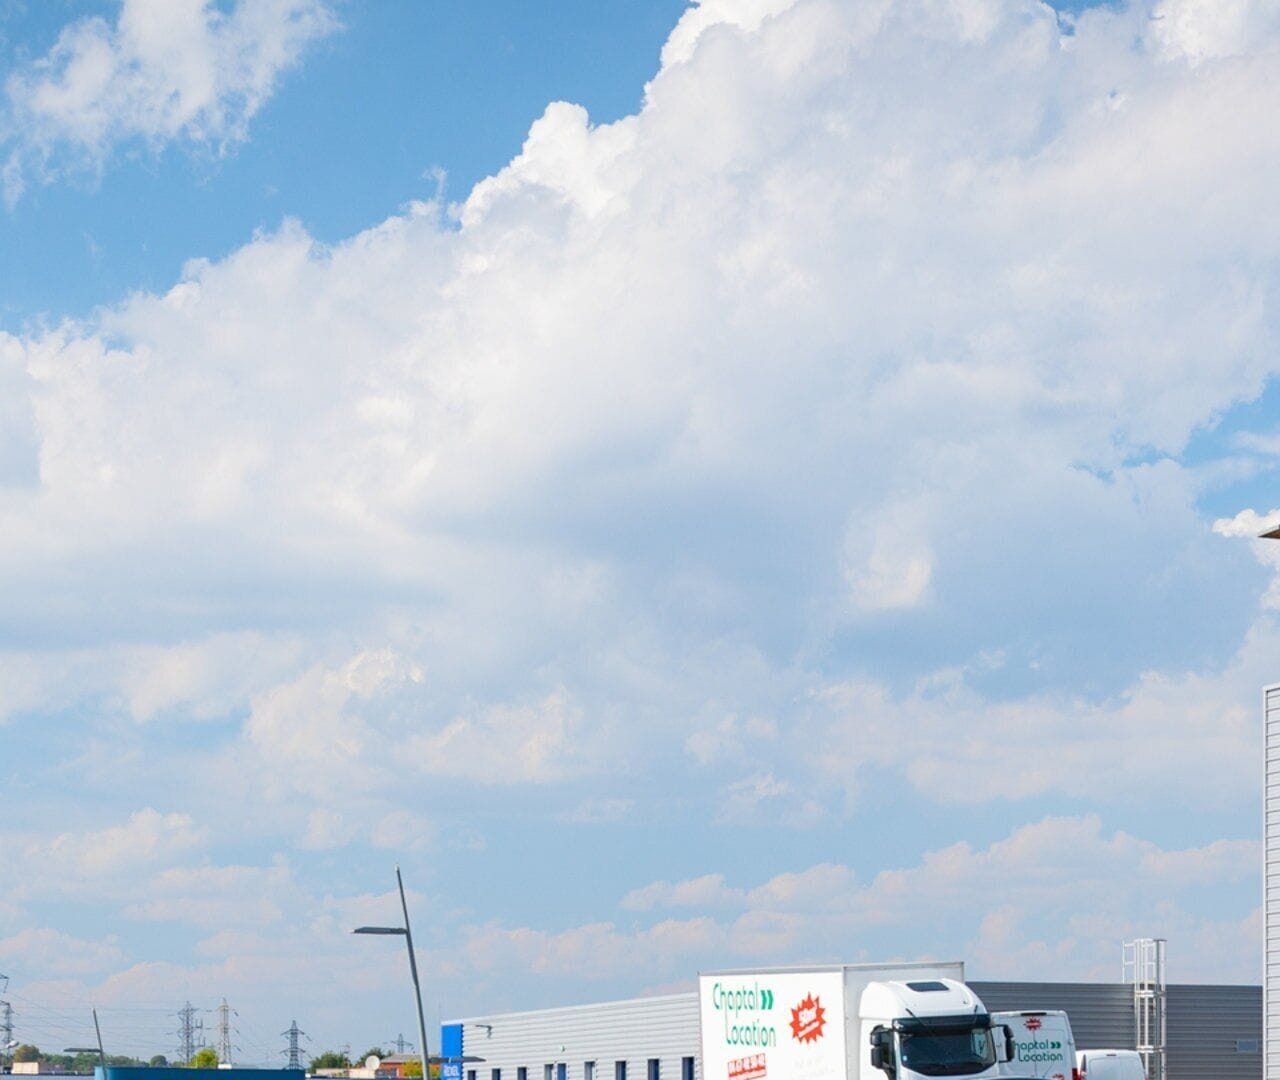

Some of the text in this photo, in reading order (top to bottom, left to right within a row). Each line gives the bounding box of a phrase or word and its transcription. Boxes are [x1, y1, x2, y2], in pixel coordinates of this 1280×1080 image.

[713, 981, 759, 1018] Chaptal
[725, 1018, 777, 1048] Location
[1014, 1039, 1049, 1052] haptal
[1018, 1049, 1063, 1062] Location
